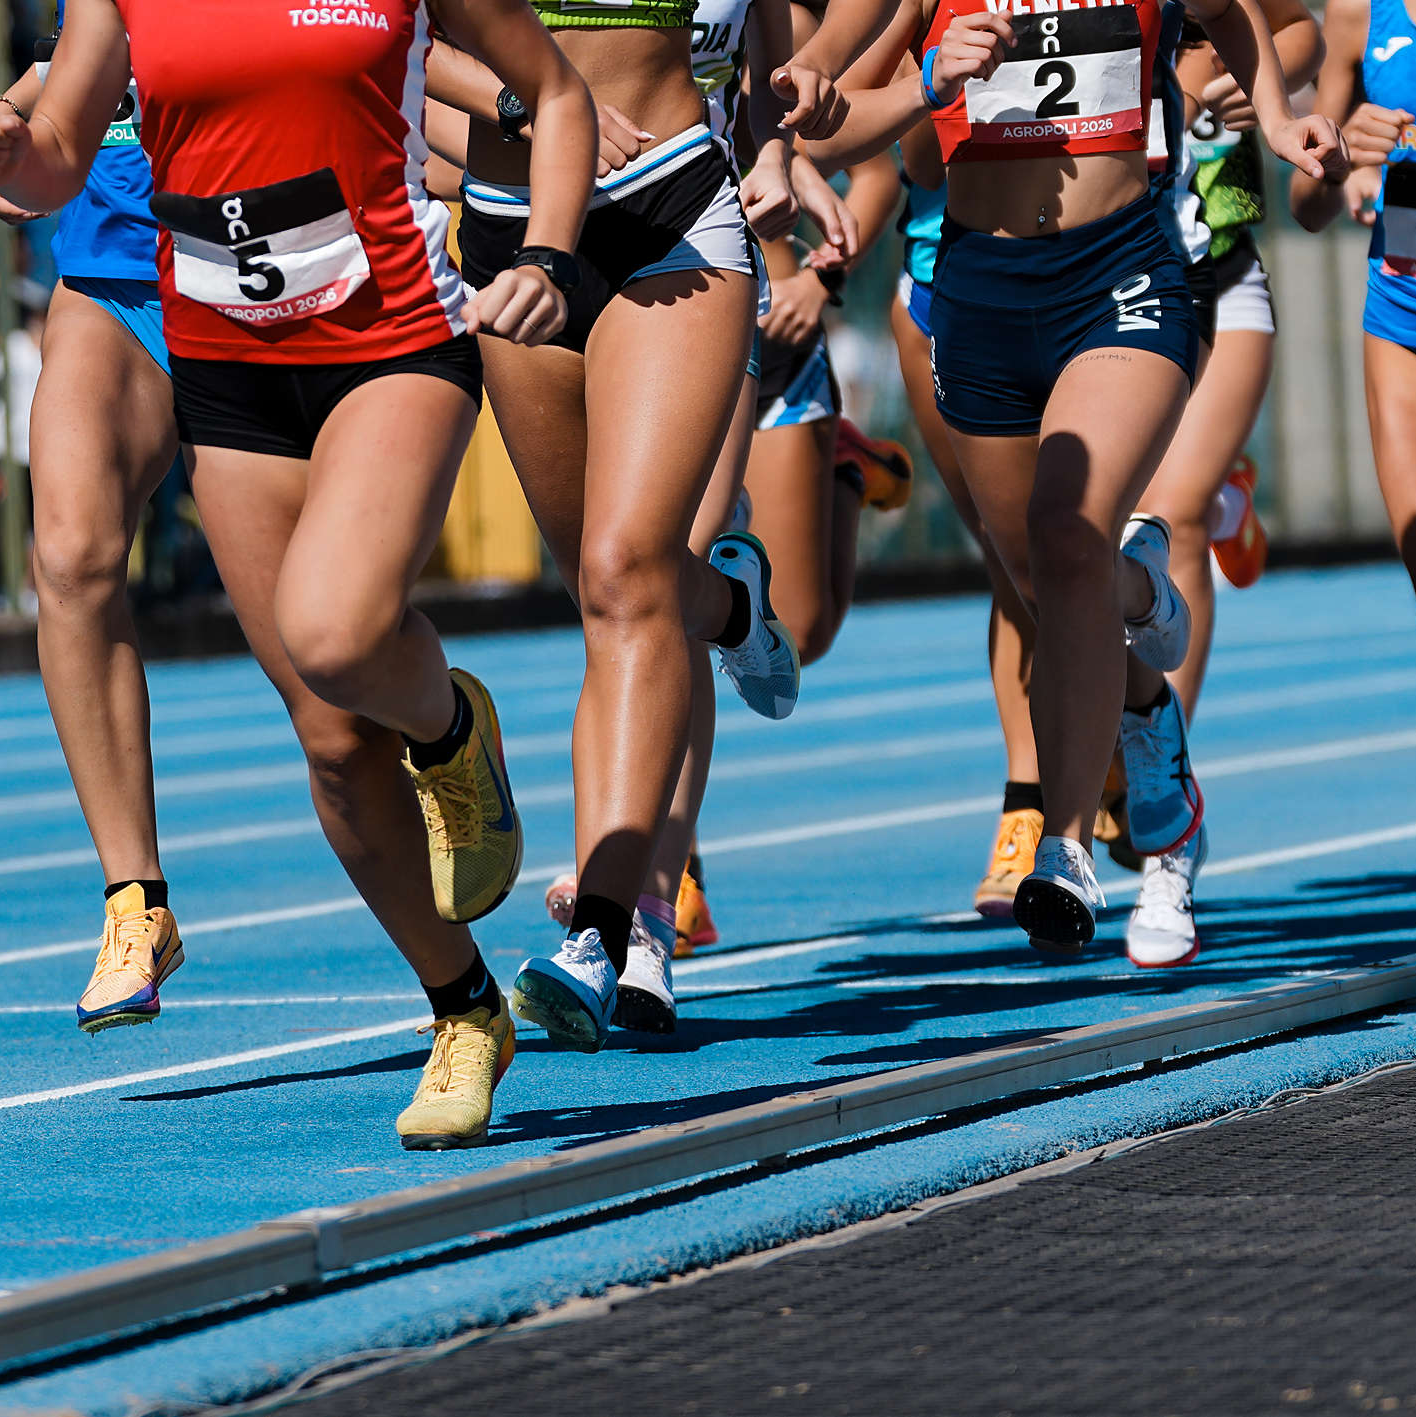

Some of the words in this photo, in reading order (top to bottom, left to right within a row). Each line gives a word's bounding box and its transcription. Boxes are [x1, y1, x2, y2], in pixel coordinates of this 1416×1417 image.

[288, 7, 389, 32] TOSCANA
[1034, 60, 1080, 119] 2
[1002, 122, 1077, 138] AGROPOLI
[1080, 118, 1114, 133] 2026
[234, 240, 286, 302] 5
[295, 287, 338, 313] 2026
